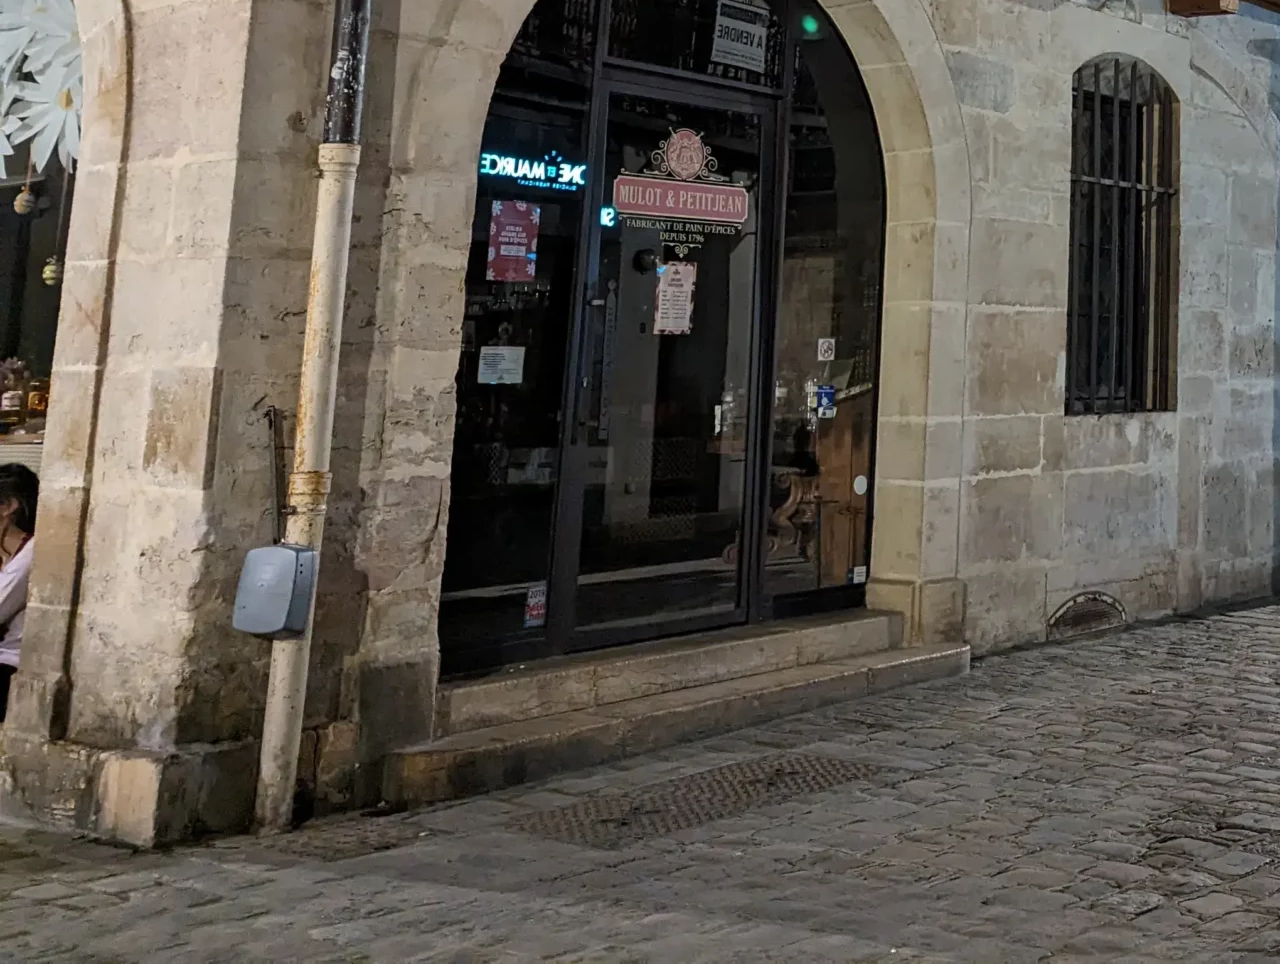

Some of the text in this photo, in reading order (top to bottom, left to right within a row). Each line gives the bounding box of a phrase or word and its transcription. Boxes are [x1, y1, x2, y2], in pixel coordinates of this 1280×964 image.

[619, 185, 743, 213] MULOT & PETITJEAN
[626, 218, 736, 235] FABRICANT DE PAIN D'ÉPICES
[659, 231, 705, 243] DEPUIS 1796
